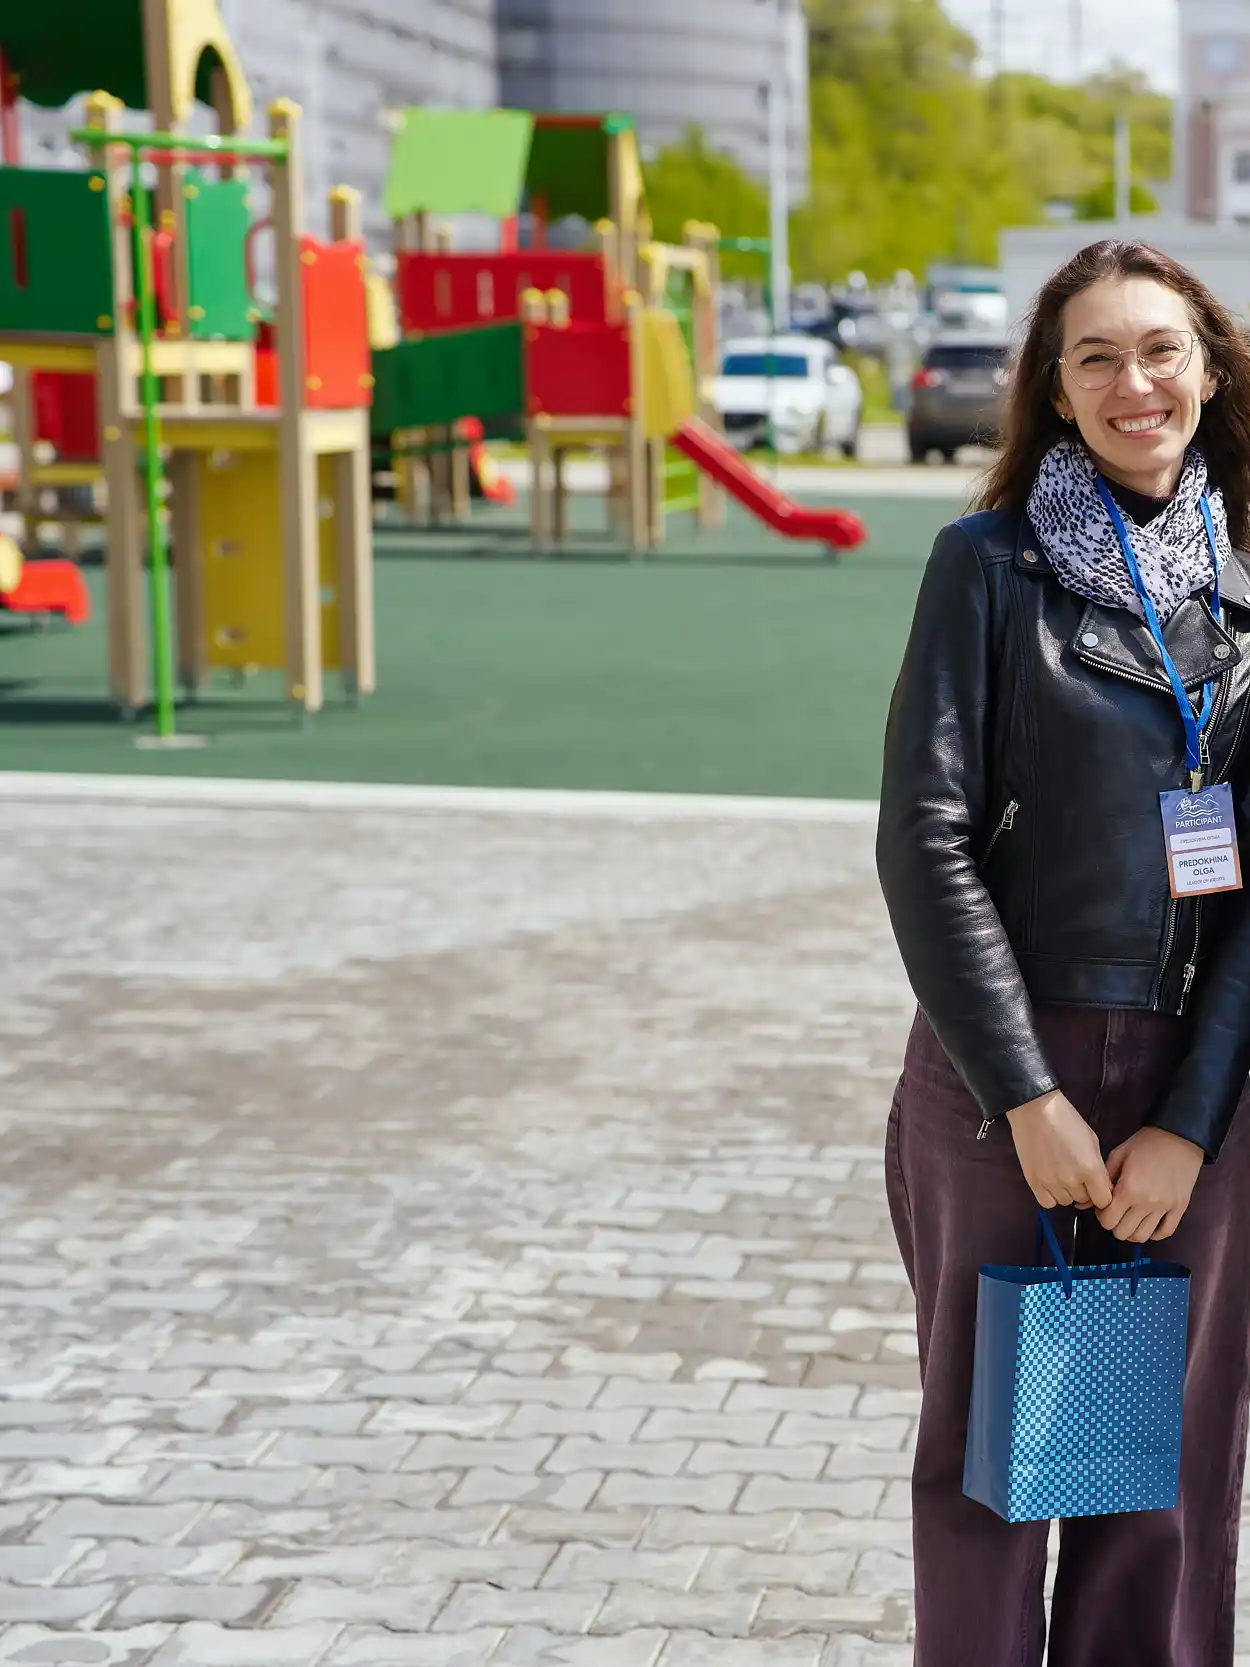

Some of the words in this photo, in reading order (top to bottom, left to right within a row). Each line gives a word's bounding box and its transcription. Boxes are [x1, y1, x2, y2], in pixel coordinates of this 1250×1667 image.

[1175, 815, 1223, 828] PARTICIPANT
[1178, 855, 1228, 868] PREDOKHINA
[1193, 867, 1215, 876] OLGA
